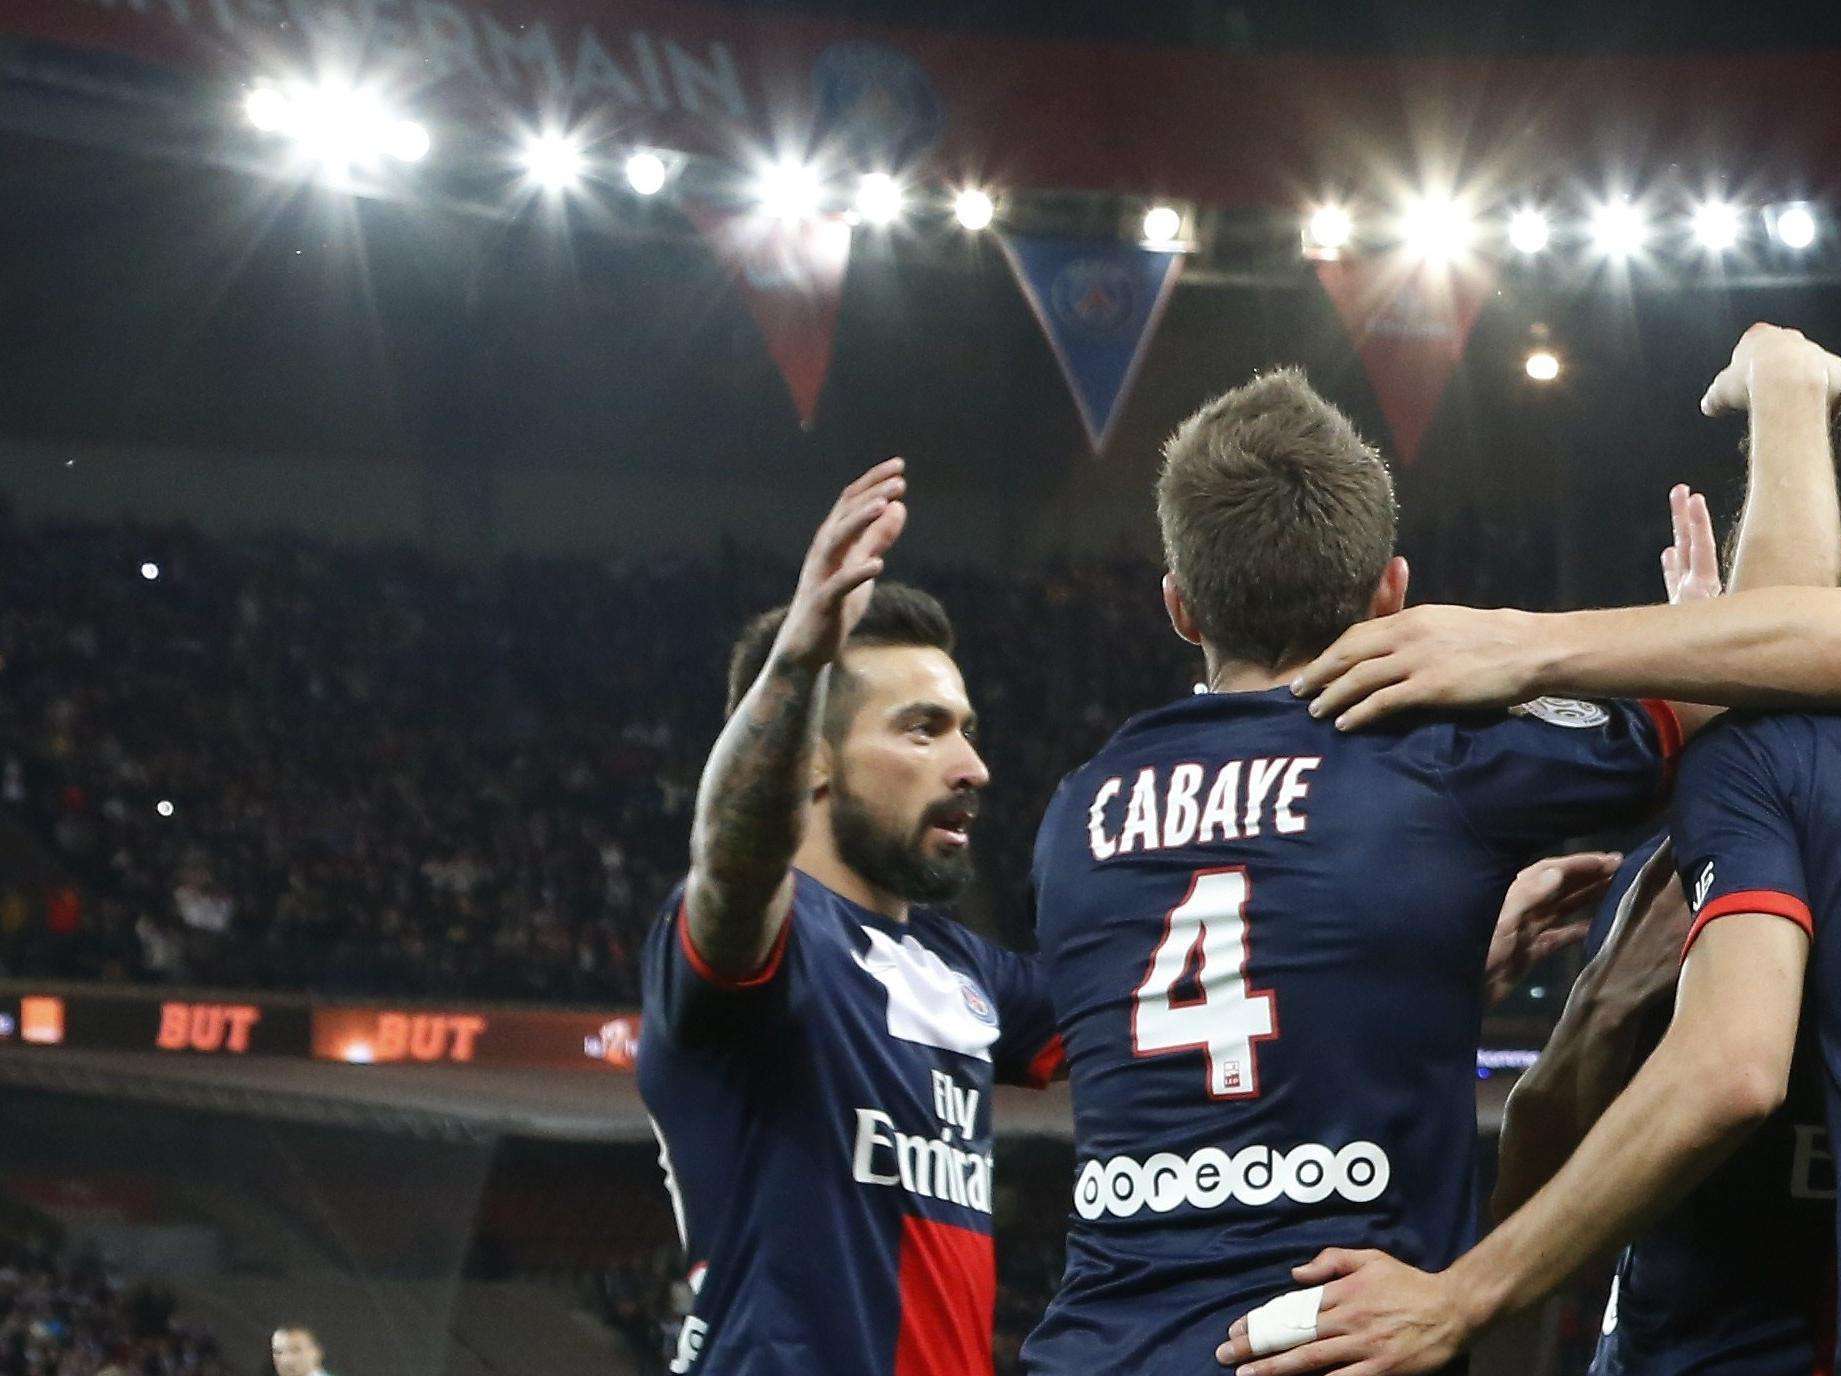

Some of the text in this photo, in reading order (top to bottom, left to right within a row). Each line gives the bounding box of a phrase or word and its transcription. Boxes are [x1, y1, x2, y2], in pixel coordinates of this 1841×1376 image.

[1087, 756, 1324, 861] CABAYE
[1131, 865, 1279, 1099] 4
[156, 1002, 262, 1053] BUT
[374, 1010, 487, 1062] BUT
[930, 1068, 980, 1142] Fly
[852, 1107, 994, 1215] Emirat
[1076, 1142, 1389, 1219] ooredoo
